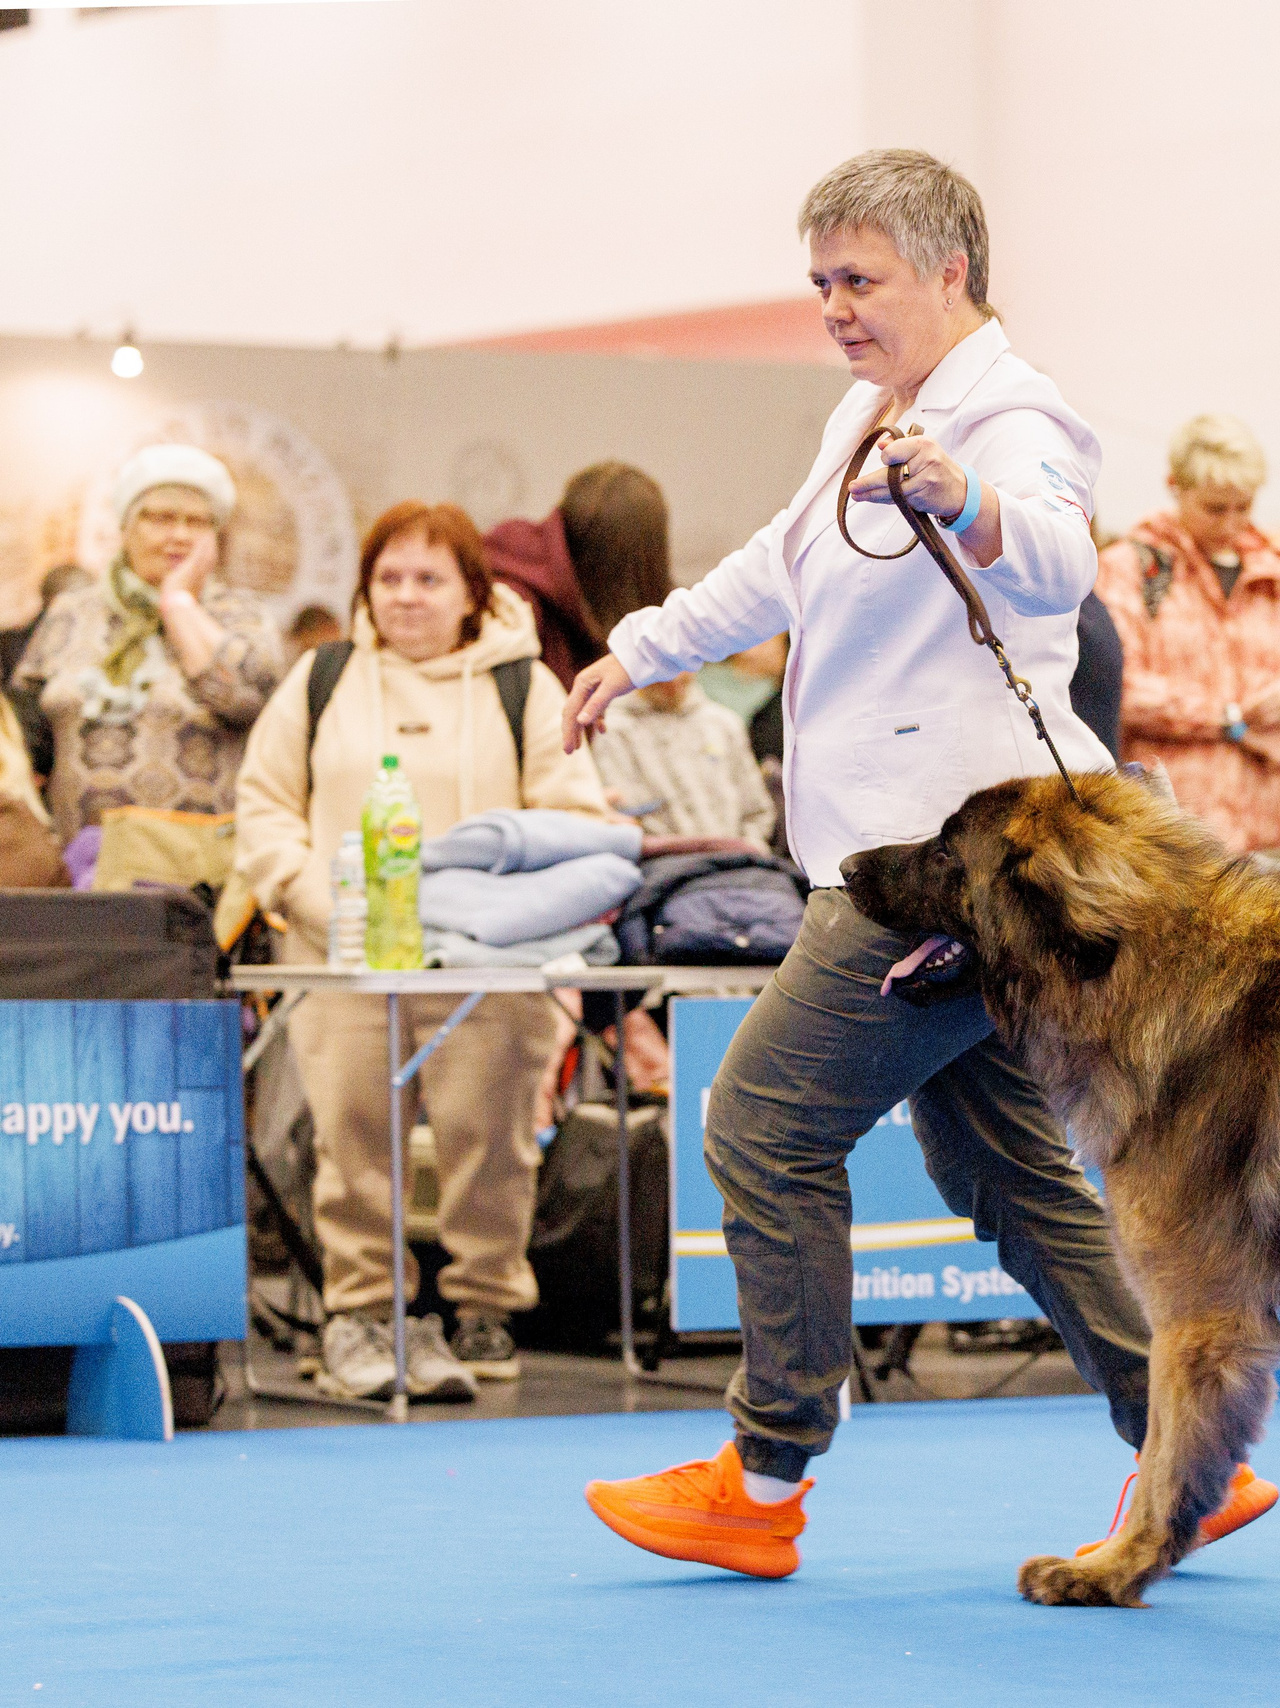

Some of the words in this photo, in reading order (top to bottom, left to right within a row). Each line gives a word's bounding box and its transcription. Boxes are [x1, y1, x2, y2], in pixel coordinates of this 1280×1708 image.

[2, 1102, 100, 1145] appy
[108, 1101, 194, 1145] you.
[852, 1266, 935, 1301] trition
